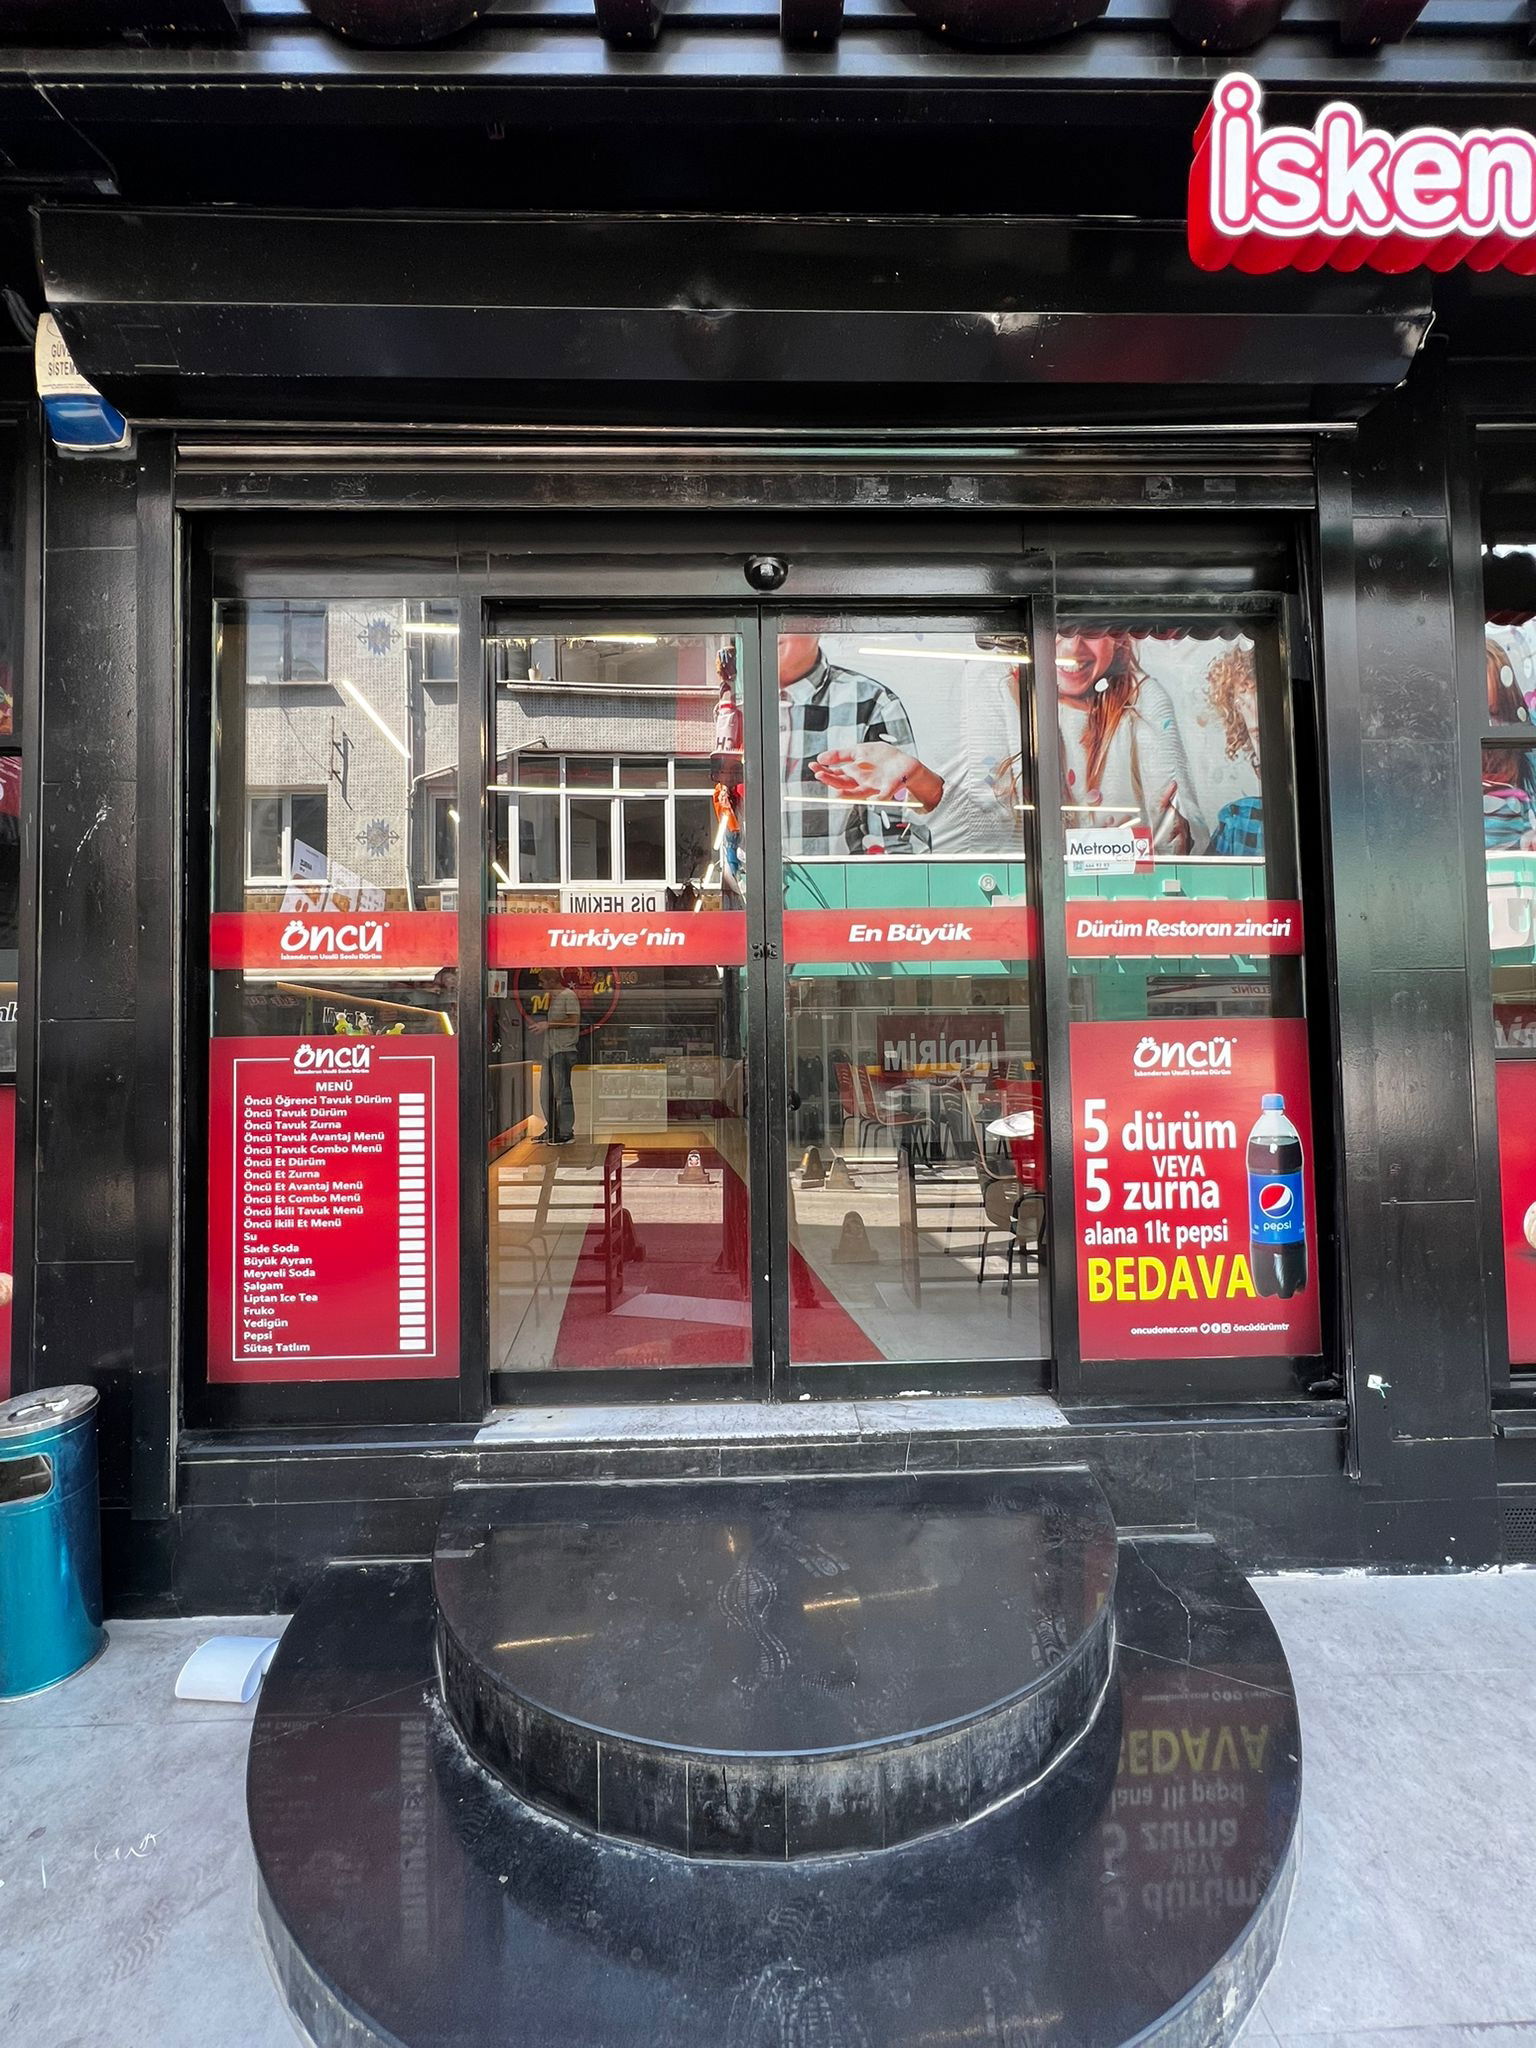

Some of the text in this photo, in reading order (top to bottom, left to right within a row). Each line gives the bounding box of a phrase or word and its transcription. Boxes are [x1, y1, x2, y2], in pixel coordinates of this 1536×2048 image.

[1070, 841, 1134, 855] Metropol
[1075, 918, 1292, 939] Dürüm Restoran zinciri
[848, 923, 974, 946] En Büyük
[315, 1080, 354, 1092] MENÜ
[244, 1095, 393, 1107] Öncü Öğrenci Tavuk Dürüm
[244, 1108, 348, 1118] Öncü Tavuk Dürüm
[244, 1120, 342, 1130] Öncü Tavuk Zurna
[1083, 1098, 1237, 1153] 5 dürüm
[244, 1132, 385, 1142] Öncü Tavuk Avantaj Menü
[244, 1144, 383, 1154] Öncü Tavuk Combo Menü
[244, 1157, 326, 1167] Öncü Et Dürüm
[1152, 1155, 1206, 1178] VEYA
[244, 1169, 321, 1179] Öncü Et Zurna
[244, 1181, 364, 1192] Öncü Et Avantaj Menü
[1085, 1157, 1221, 1213] 5 zurna
[244, 1194, 361, 1204] Öncü Et Combo Menü
[244, 1205, 364, 1216] Öncü İkili Tavuk Menü
[244, 1218, 273, 1228] Öncü
[297, 1219, 309, 1228] Et
[311, 1218, 342, 1227] Menü
[1263, 1220, 1292, 1232] pepsi
[244, 1232, 258, 1241] Su
[1084, 1218, 1229, 1250] alana 1lt pepsi
[244, 1244, 300, 1253] Sade Soda
[244, 1256, 313, 1267] Büyük Ayran
[244, 1268, 316, 1280] Meyveli Soda
[1087, 1253, 1258, 1303] BEDAVA
[244, 1282, 284, 1292] Şalgam
[244, 1293, 319, 1305] Liptan Ice Tea
[244, 1306, 276, 1316] Fruko
[243, 1318, 289, 1329] Yedigün
[1130, 1325, 1198, 1335] oncudoner.com
[244, 1331, 273, 1342] Pepsi
[244, 1343, 311, 1354] Sütaş Tatlım
